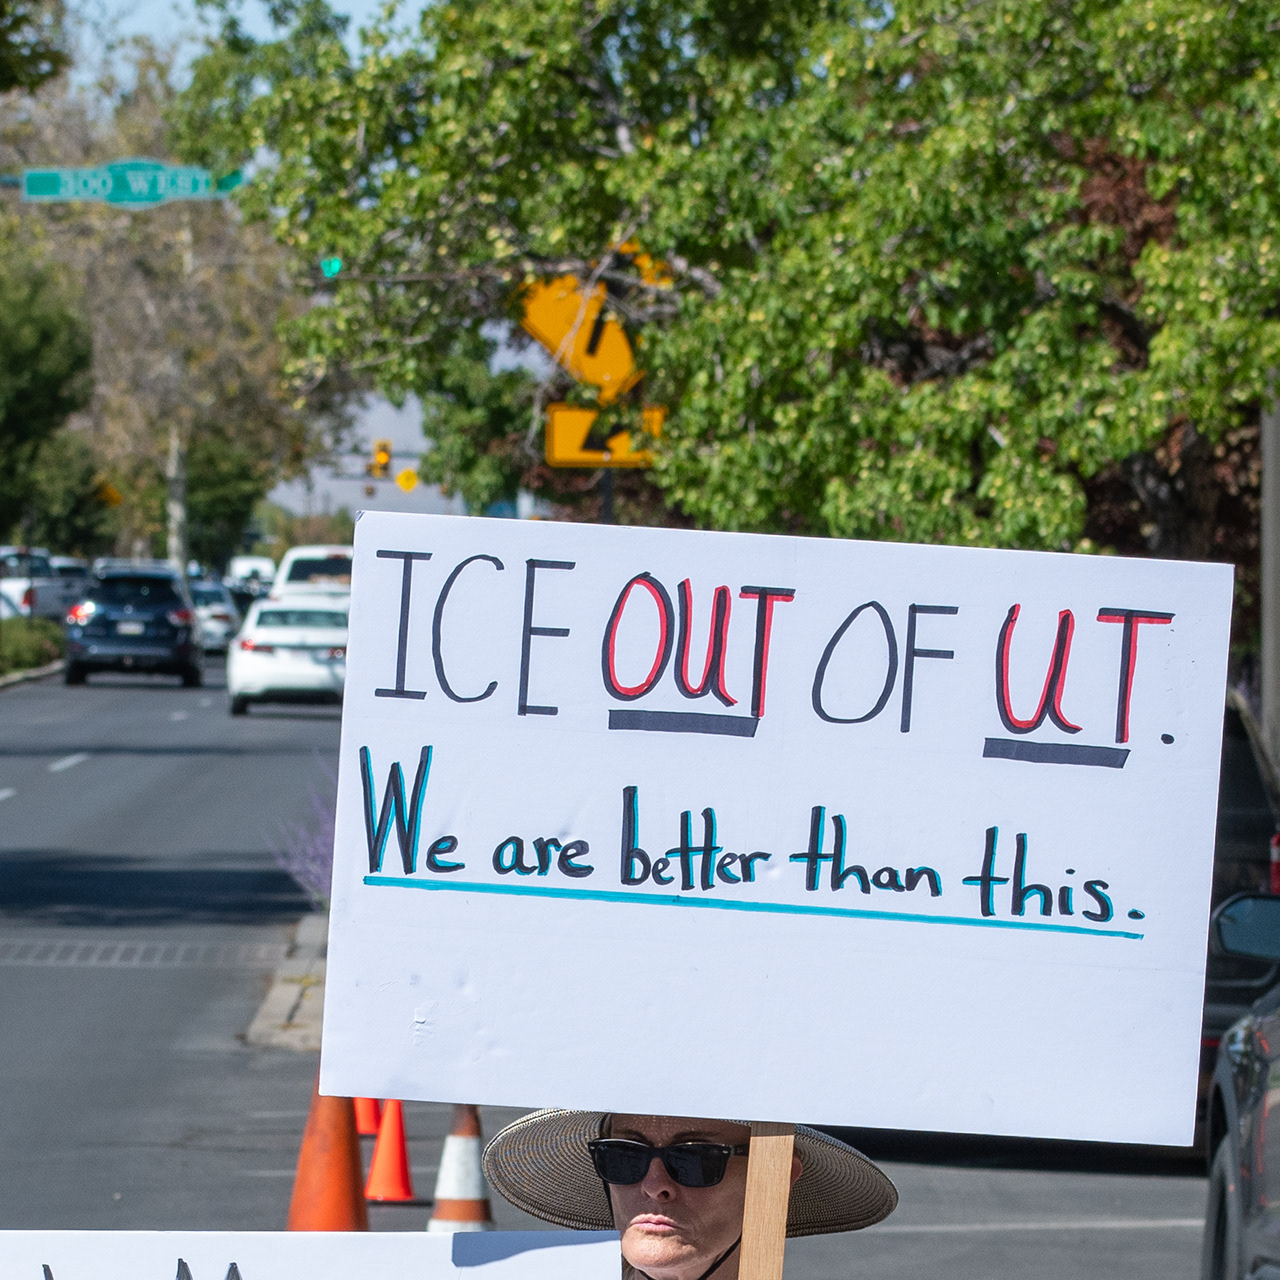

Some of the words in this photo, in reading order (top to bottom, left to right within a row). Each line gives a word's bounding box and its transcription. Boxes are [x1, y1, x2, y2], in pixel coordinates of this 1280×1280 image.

[126, 169, 213, 196] WEST
[375, 550, 576, 717] ICE
[601, 571, 796, 719] OUT
[811, 601, 960, 733] OF
[994, 603, 1176, 746] UT.
[359, 744, 466, 876] We
[492, 835, 595, 878] are
[621, 785, 772, 892] better
[788, 805, 943, 897] than
[961, 825, 1146, 922] this.
